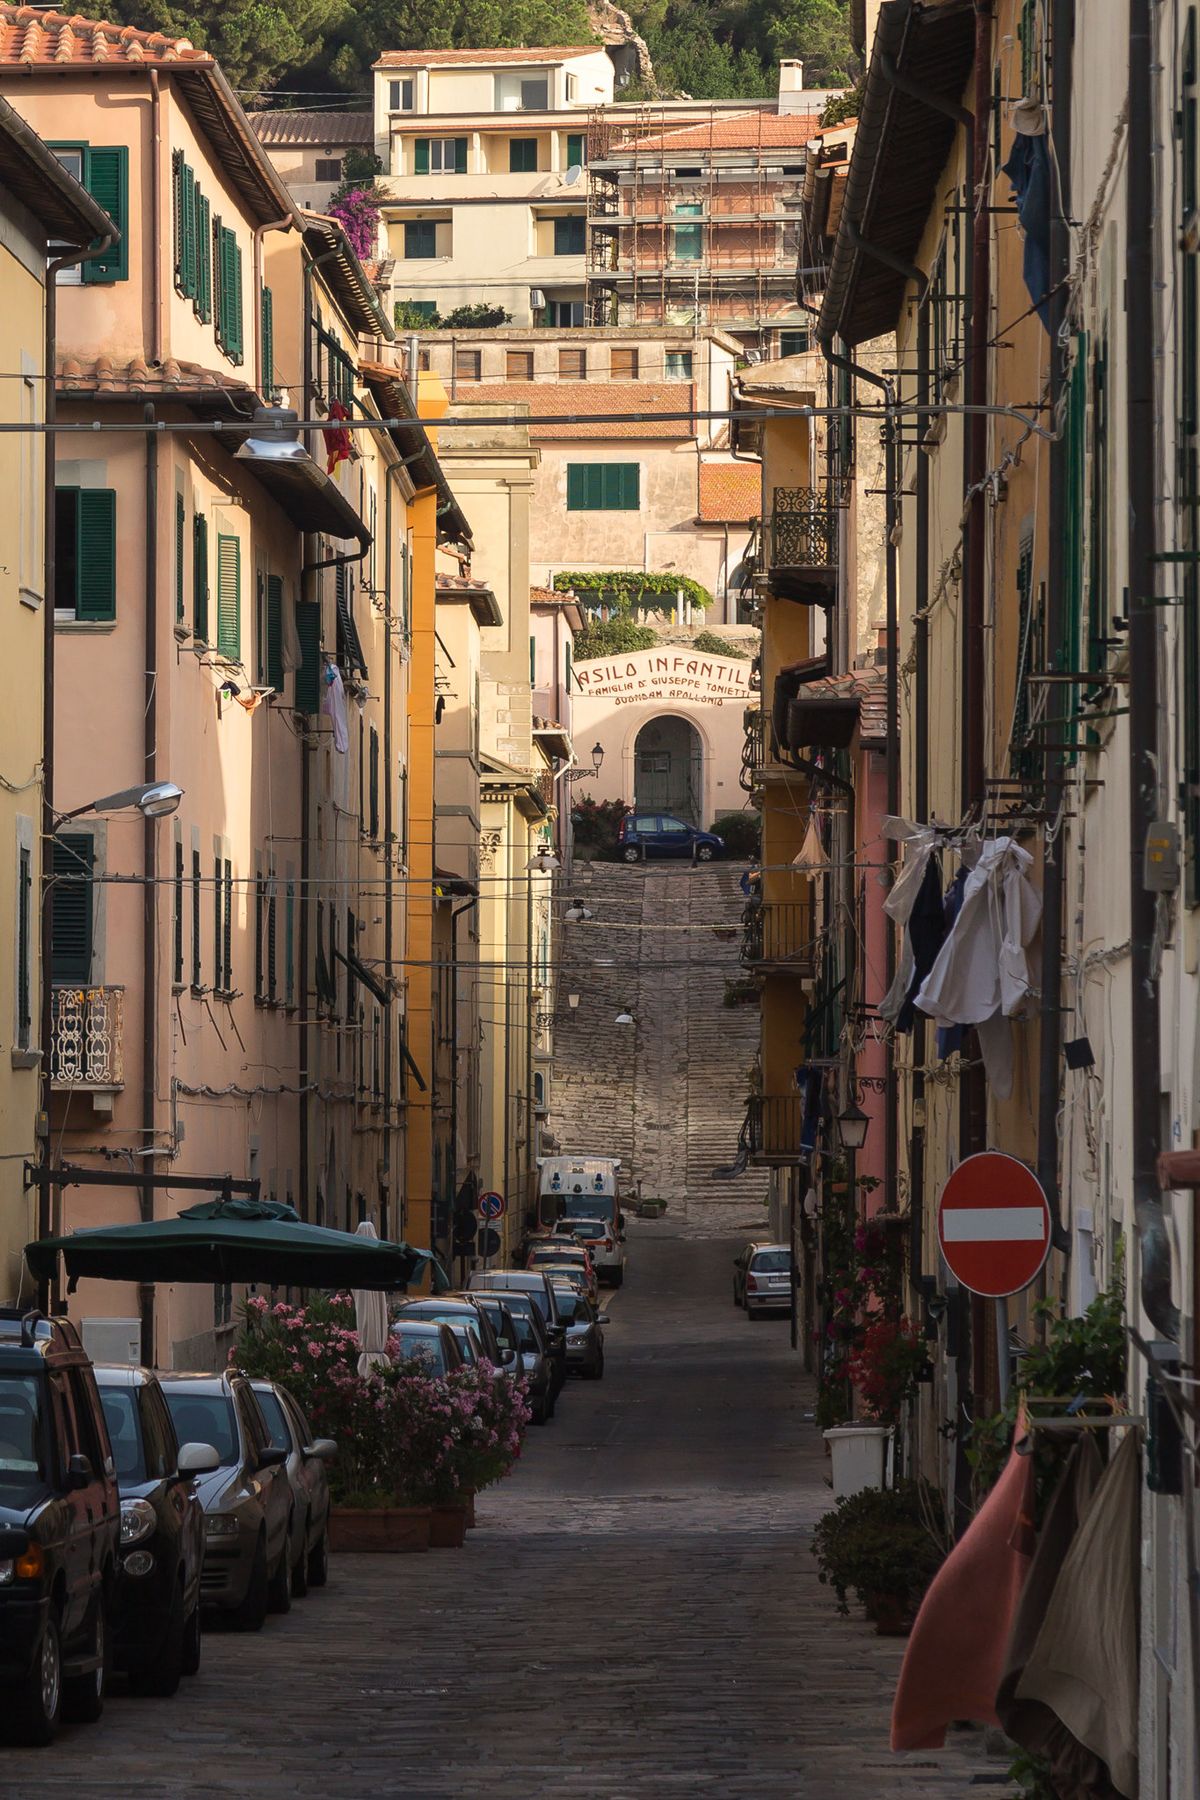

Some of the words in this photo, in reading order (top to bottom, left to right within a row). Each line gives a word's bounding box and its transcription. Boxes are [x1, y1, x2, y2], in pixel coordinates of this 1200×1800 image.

[578, 662, 637, 685] ASILO
[588, 682, 634, 696] FAMIGLIA
[651, 676, 701, 689] GIUSEPPE
[706, 682, 751, 699] TONIETTI
[669, 689, 723, 707] APOLLONIO
